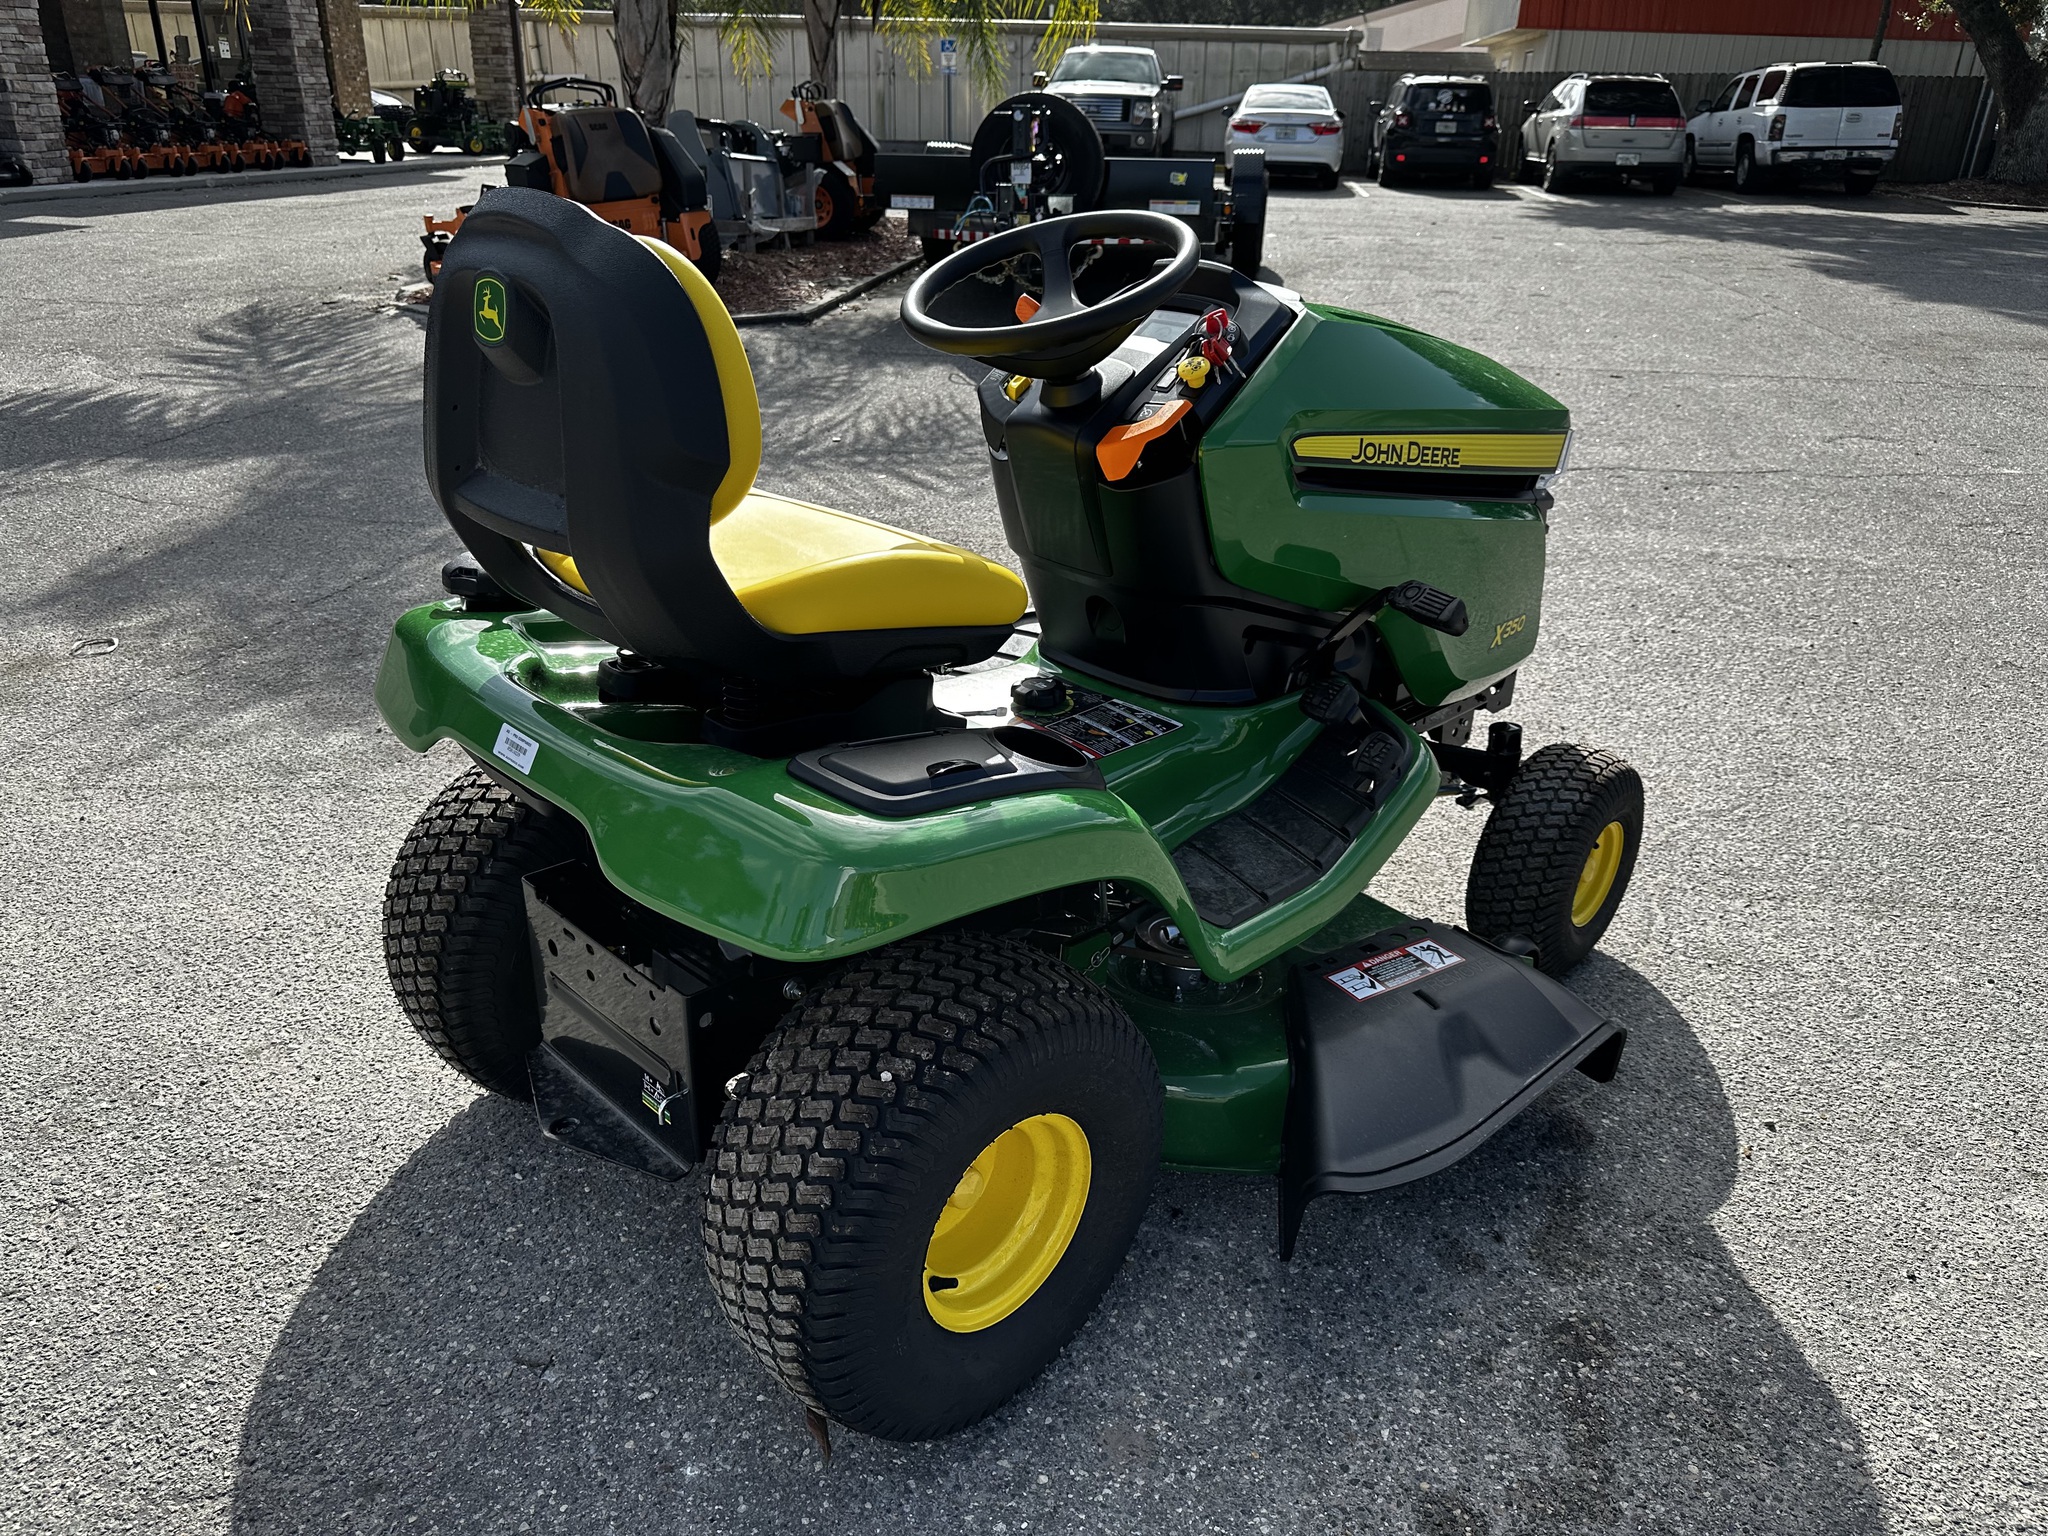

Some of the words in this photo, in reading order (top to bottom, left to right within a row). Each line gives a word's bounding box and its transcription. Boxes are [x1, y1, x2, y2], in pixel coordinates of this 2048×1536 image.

[1350, 438, 1404, 464] JOHN
[1406, 440, 1461, 467] DEERE
[1490, 614, 1526, 648] X350
[1369, 950, 1402, 965] DANGER
